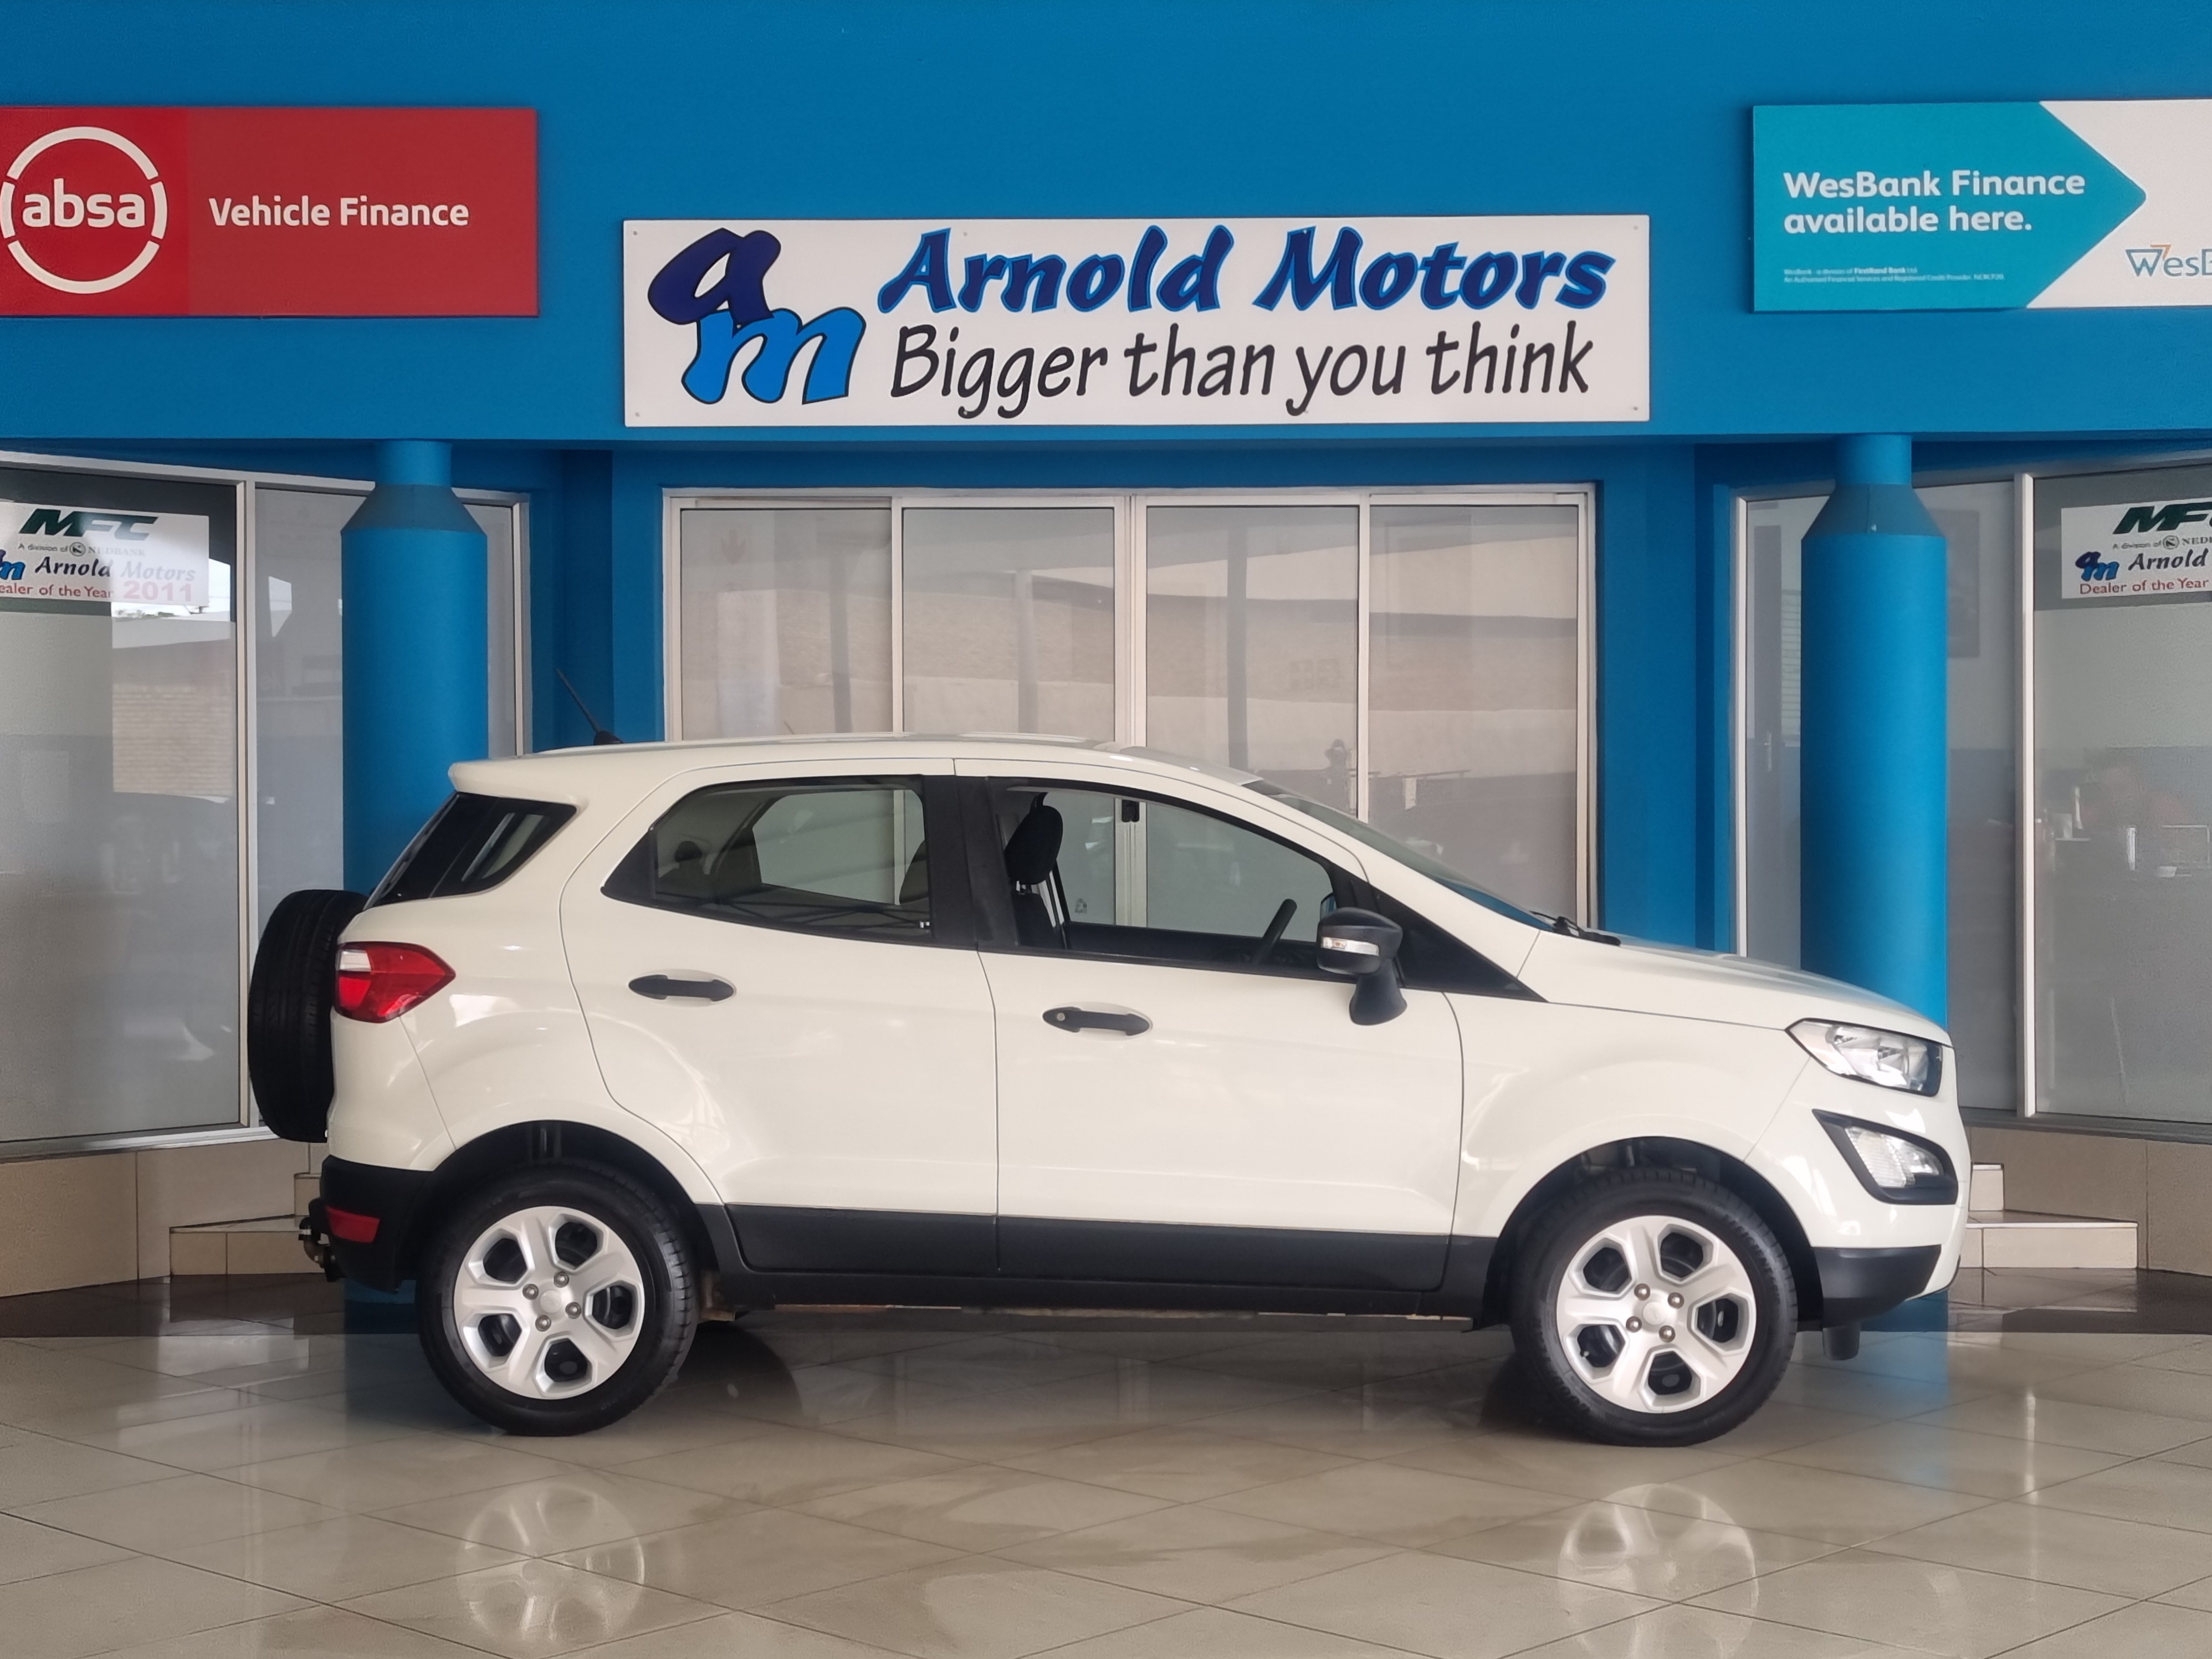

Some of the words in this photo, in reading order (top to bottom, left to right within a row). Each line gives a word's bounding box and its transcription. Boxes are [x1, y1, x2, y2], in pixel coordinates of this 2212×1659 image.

[1783, 171, 1941, 198] WesBank
[1952, 170, 2085, 196] Finance
[22, 178, 146, 228] absa
[209, 195, 330, 226] Vehicle
[340, 195, 469, 226] Finance
[1784, 206, 1939, 234] available
[1949, 205, 2032, 232] here.
[877, 226, 1234, 313] Arnold
[1252, 226, 1616, 311] Motors
[890, 324, 1108, 419] Bigger
[1124, 323, 1275, 397] than
[1291, 345, 1406, 416] you
[1426, 320, 1594, 395] think
[18, 508, 158, 541] MFC
[2112, 501, 2212, 534] MF
[2181, 536, 2212, 546] NED
[34, 556, 114, 577] Arnold
[120, 560, 197, 582] Motors
[2127, 547, 2209, 571] Arnold
[39, 583, 54, 596] of
[59, 585, 81, 597] the
[84, 586, 114, 599] Year
[123, 581, 192, 602] 2011
[2080, 582, 2127, 595] Dealer
[2132, 580, 2148, 592] of
[2152, 578, 2175, 591] the
[2177, 577, 2210, 590] Year
